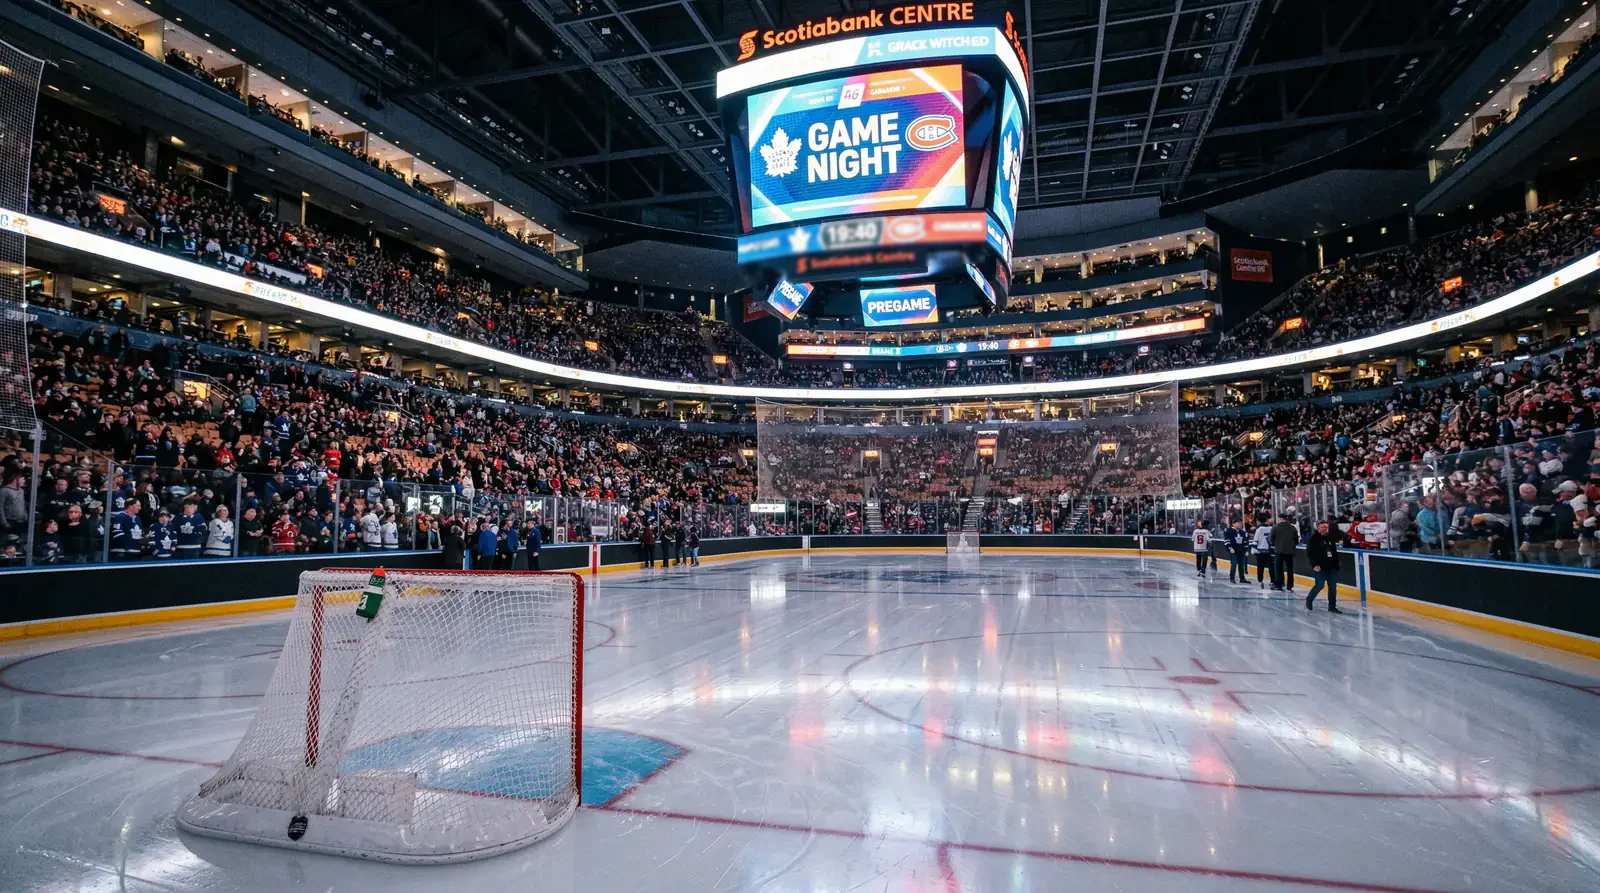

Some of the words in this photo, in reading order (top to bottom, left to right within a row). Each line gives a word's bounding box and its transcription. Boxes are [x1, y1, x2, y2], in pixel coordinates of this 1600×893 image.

[763, 10, 884, 49] Scotiabank
[889, 2, 974, 25] CENTRE
[929, 35, 990, 49] WITCHED
[808, 111, 900, 152] GAME
[807, 143, 902, 183] NIGHT
[827, 224, 877, 242] 19:40
[867, 297, 931, 314] PREGAME
[977, 341, 999, 350] 19:40
